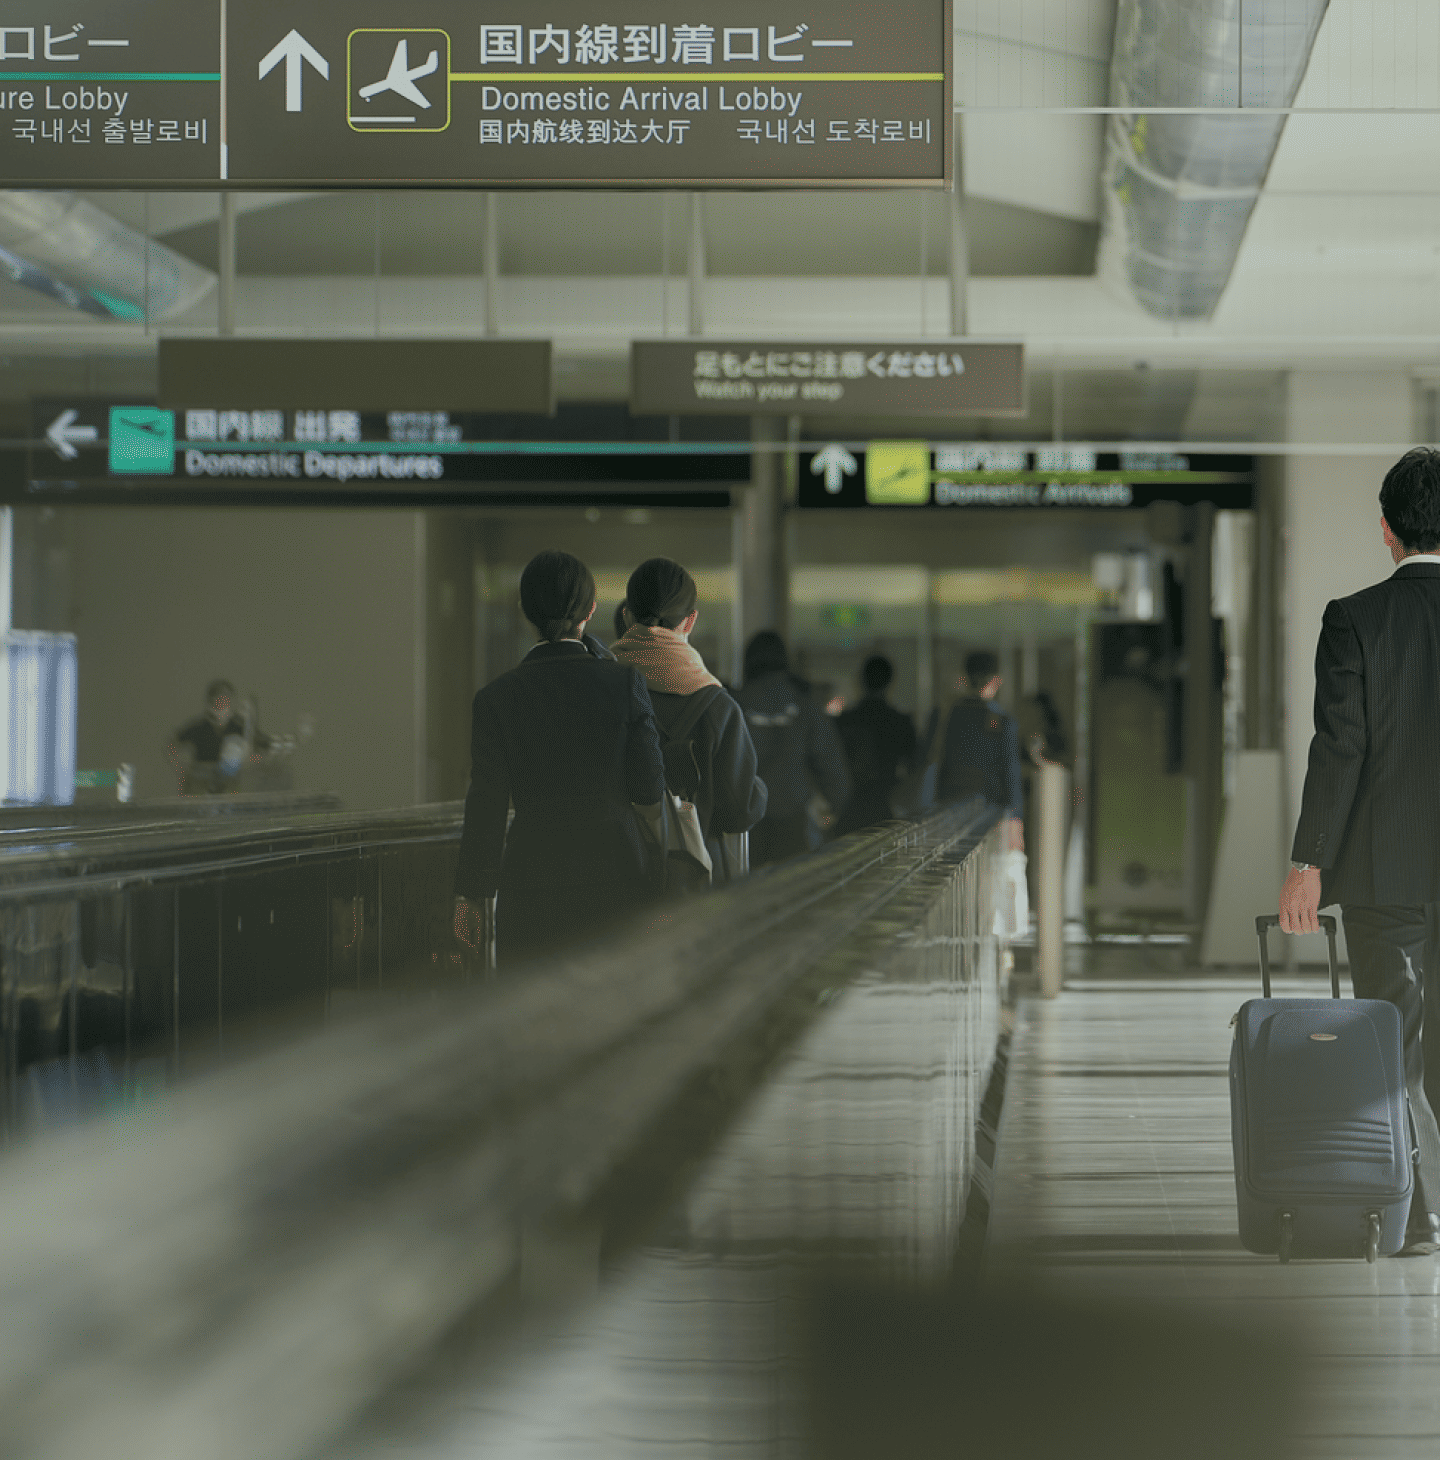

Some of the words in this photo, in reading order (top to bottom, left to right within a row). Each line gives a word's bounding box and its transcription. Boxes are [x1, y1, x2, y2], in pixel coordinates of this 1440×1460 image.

[0, 22, 130, 61] ロビー
[480, 22, 854, 65] 国内線到着ロビー
[46, 85, 129, 114] Lobby
[482, 86, 610, 111] Domestic
[619, 86, 707, 111] Arrival
[719, 86, 803, 117] Lobby
[12, 118, 91, 144] 국내선
[101, 117, 207, 144] 출발로비
[479, 118, 691, 145] 国内航线到达大厅
[736, 118, 815, 145] 국내선
[825, 118, 931, 145] 도착로비
[694, 380, 755, 400] Watch
[757, 382, 798, 403] your
[184, 449, 301, 477] Domestic
[303, 449, 445, 483] Departures
